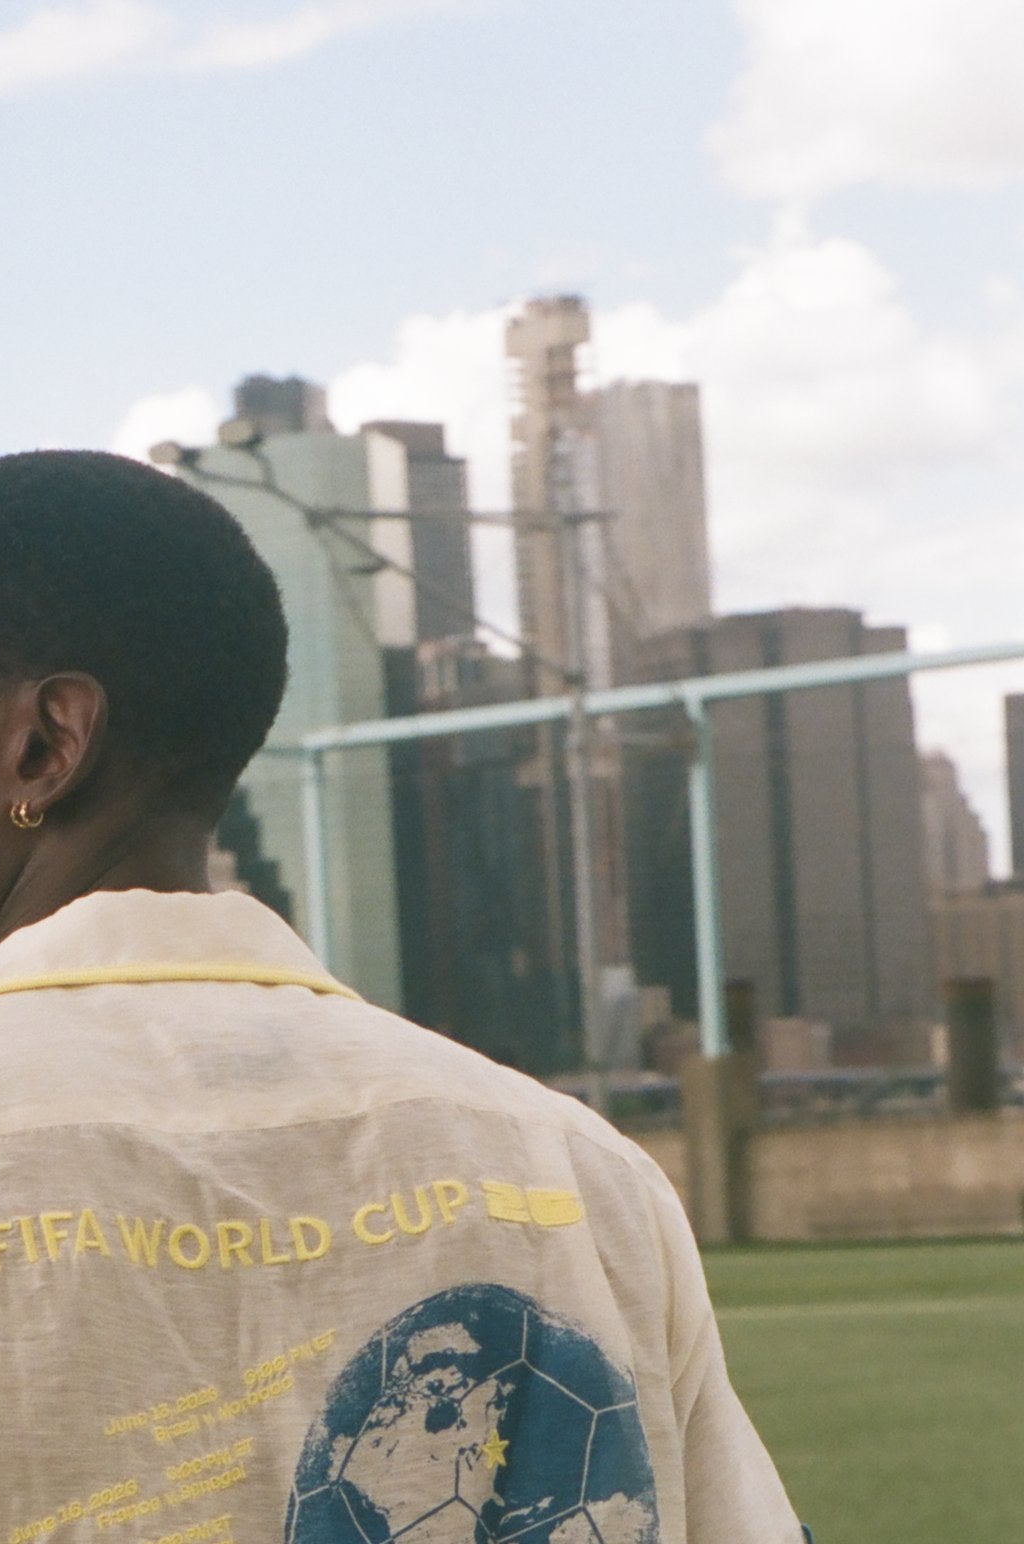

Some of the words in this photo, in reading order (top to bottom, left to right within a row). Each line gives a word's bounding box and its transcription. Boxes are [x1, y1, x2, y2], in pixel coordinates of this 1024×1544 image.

[117, 1216, 331, 1270] WORLD
[352, 1179, 468, 1245] CUP
[480, 1181, 585, 1227] 26
[106, 1414, 146, 1435] June
[178, 1387, 218, 1412] 2026
[155, 1418, 199, 1441] Brazil
[221, 1377, 294, 1419] Morocco
[91, 1481, 138, 1509] 2026
[99, 1498, 160, 1528] France
[182, 1465, 246, 1497] Senegal
